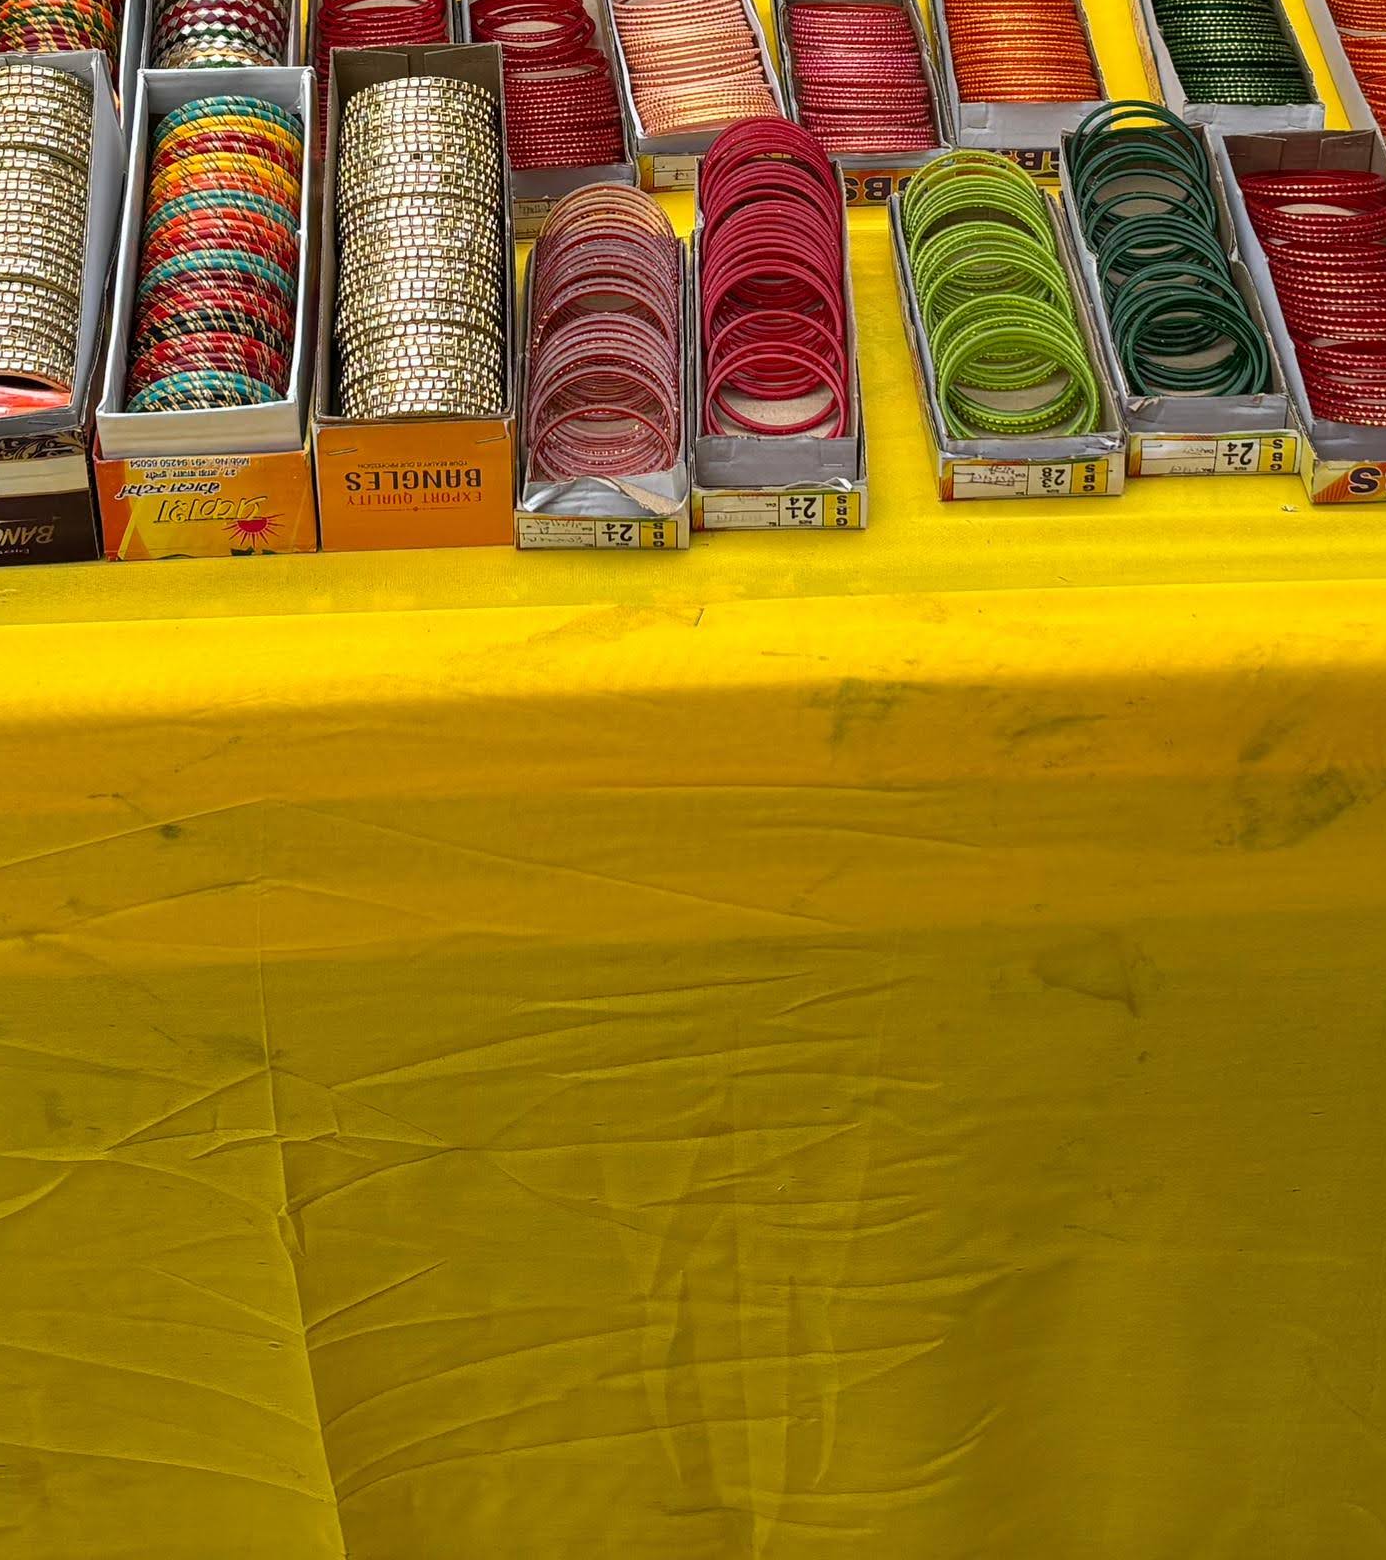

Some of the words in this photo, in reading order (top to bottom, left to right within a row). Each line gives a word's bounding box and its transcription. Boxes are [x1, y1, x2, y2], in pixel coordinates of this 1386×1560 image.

[344, 468, 482, 492] BANGLES
[346, 493, 413, 506] QUALITY
[422, 491, 482, 504] EXPORT
[153, 496, 269, 524] प्रकाश
